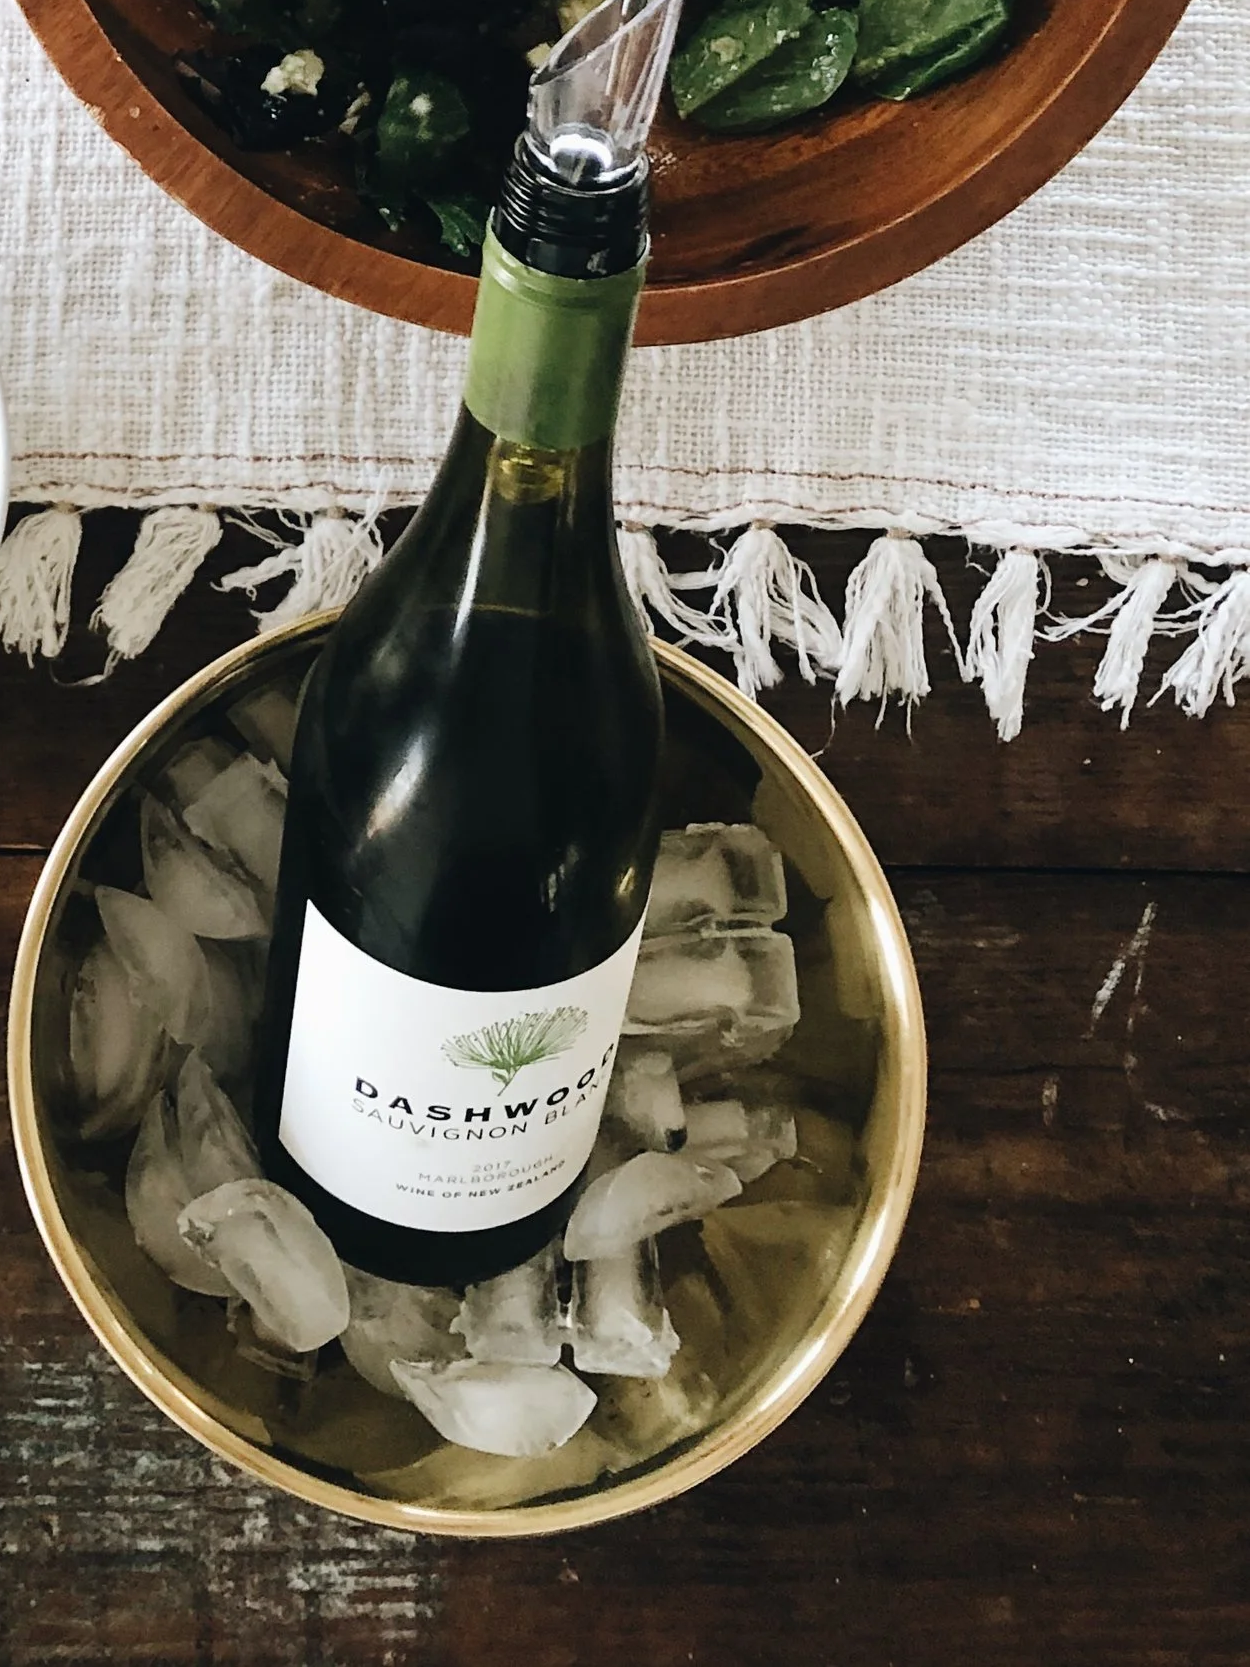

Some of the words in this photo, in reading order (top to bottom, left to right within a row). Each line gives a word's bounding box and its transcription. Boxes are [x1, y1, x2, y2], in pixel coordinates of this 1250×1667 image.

[352, 1097, 527, 1140] SAUVIGNON
[544, 1070, 607, 1125] BLAN
[396, 1183, 435, 1197] WINE
[442, 1191, 462, 1199] OF
[468, 1187, 501, 1198] NEW
[507, 1159, 566, 1192] ZEALAND
[417, 1154, 554, 1184] MARLBOROUGH
[472, 1159, 511, 1173] 2017
